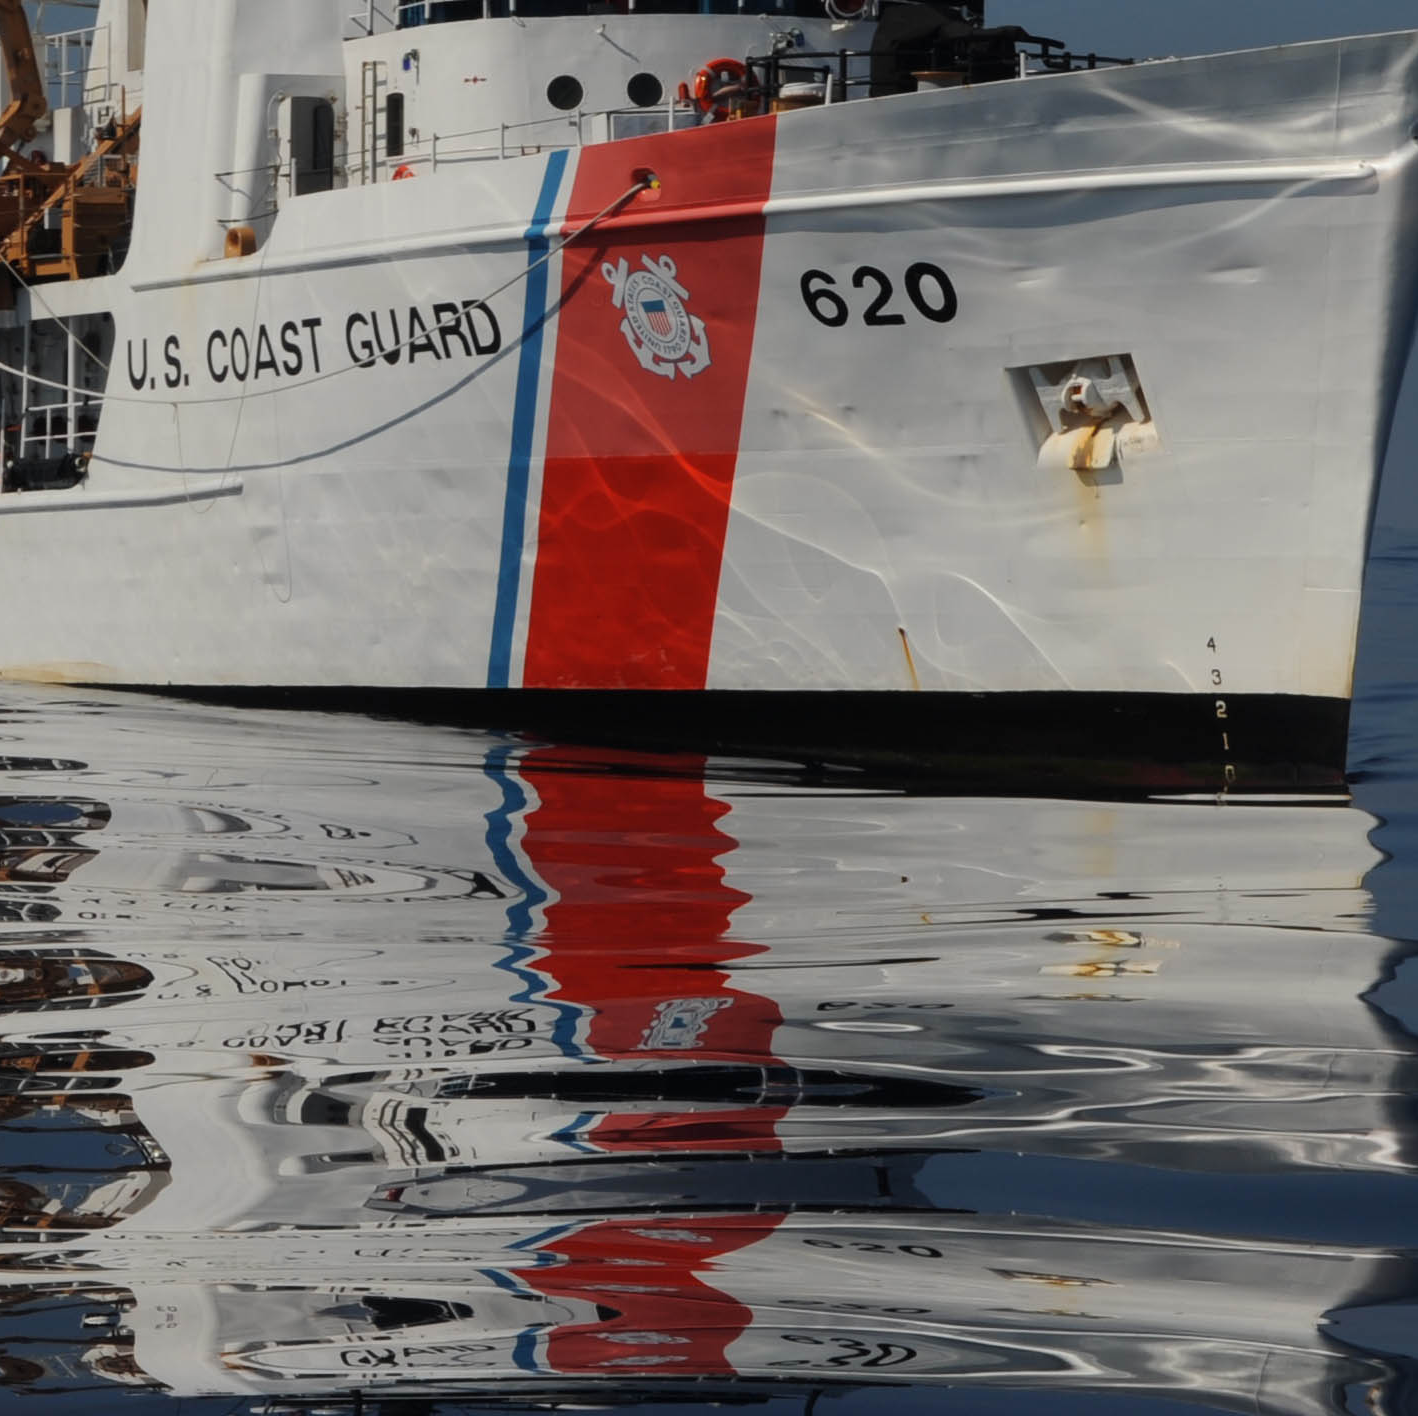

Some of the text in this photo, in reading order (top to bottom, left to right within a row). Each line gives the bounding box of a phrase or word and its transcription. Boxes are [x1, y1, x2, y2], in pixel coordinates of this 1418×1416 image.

[643, 275, 673, 298] COAST
[672, 300, 687, 343] GUARD
[801, 261, 958, 328] 620
[127, 299, 502, 391] U.S. COAST GUARD
[1206, 637, 1217, 653] 4
[1211, 669, 1222, 685] 3
[1215, 700, 1228, 718] 2
